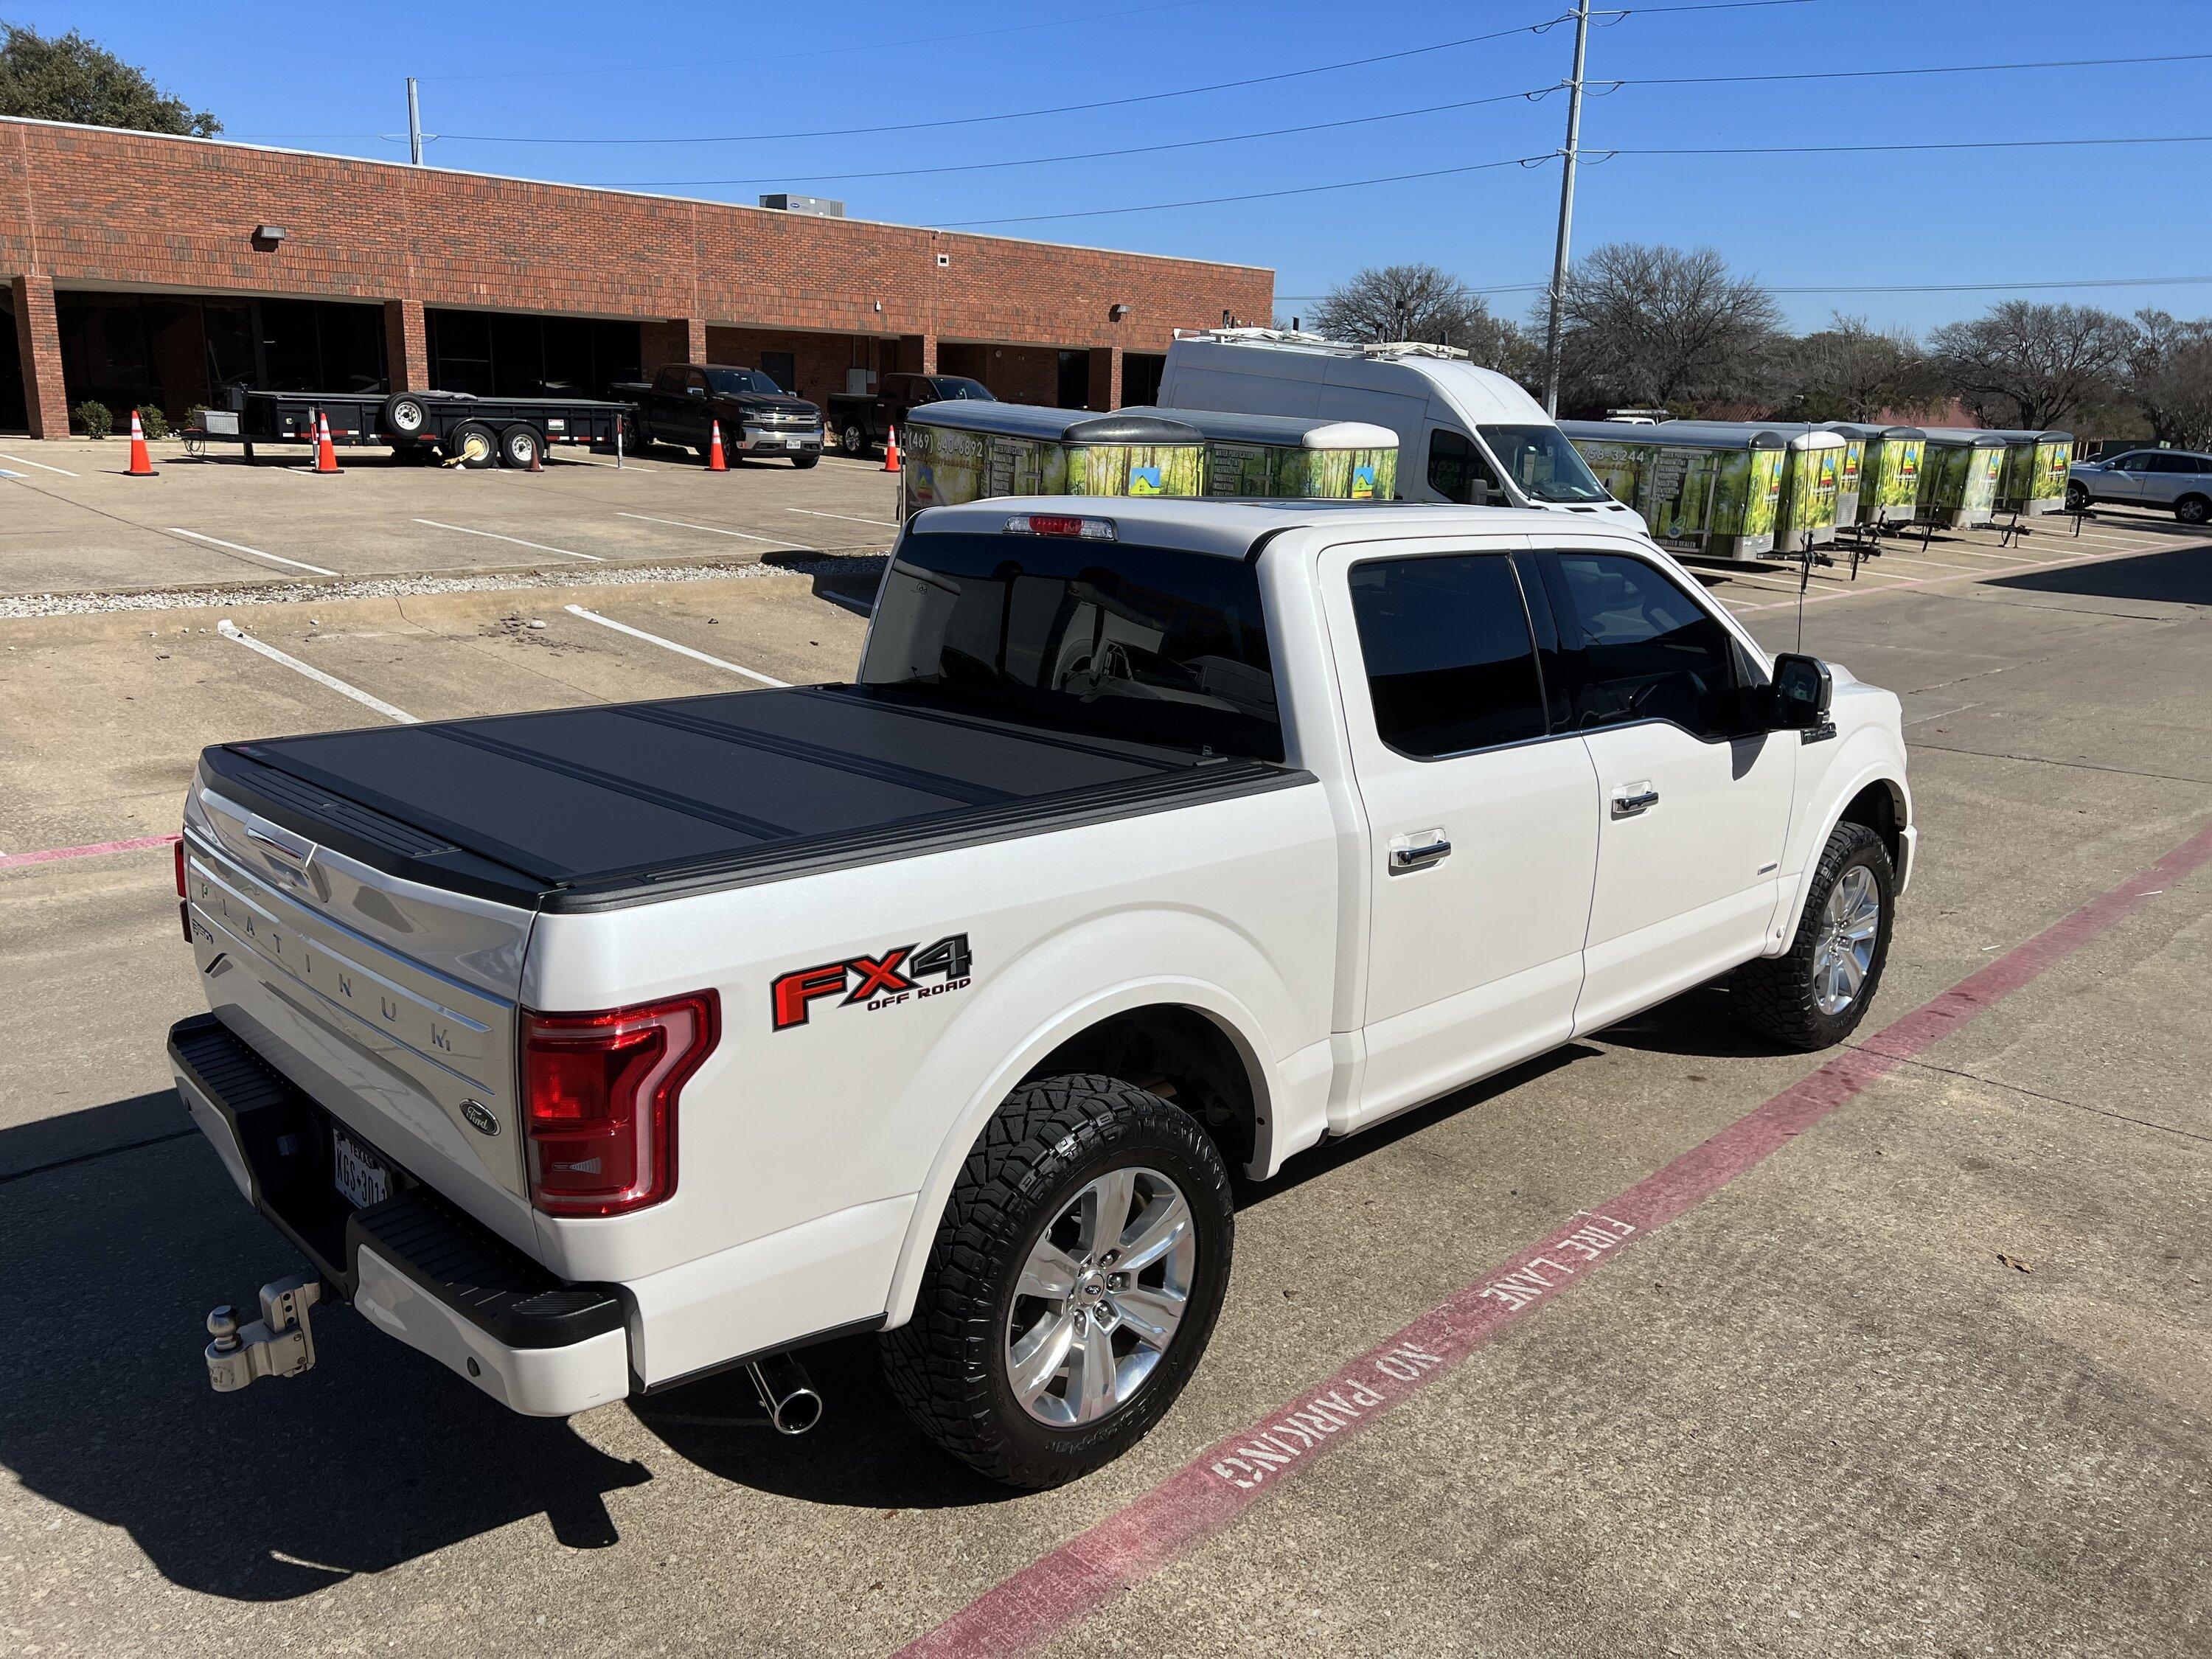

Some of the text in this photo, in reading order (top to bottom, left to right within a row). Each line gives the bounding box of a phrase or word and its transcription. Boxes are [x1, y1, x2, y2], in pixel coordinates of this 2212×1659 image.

[909, 431, 983, 458] (469) 640-6892
[1582, 448, 1644, 463] 758-3244
[201, 883, 451, 1052] PLATINUM
[769, 931, 973, 1033] FX4
[866, 977, 972, 1012] OFF ROAD
[466, 1106, 488, 1130] Ford
[349, 1144, 374, 1169] TEXAS
[1210, 1215, 1636, 1489] FIRE LANE NO PARKING
